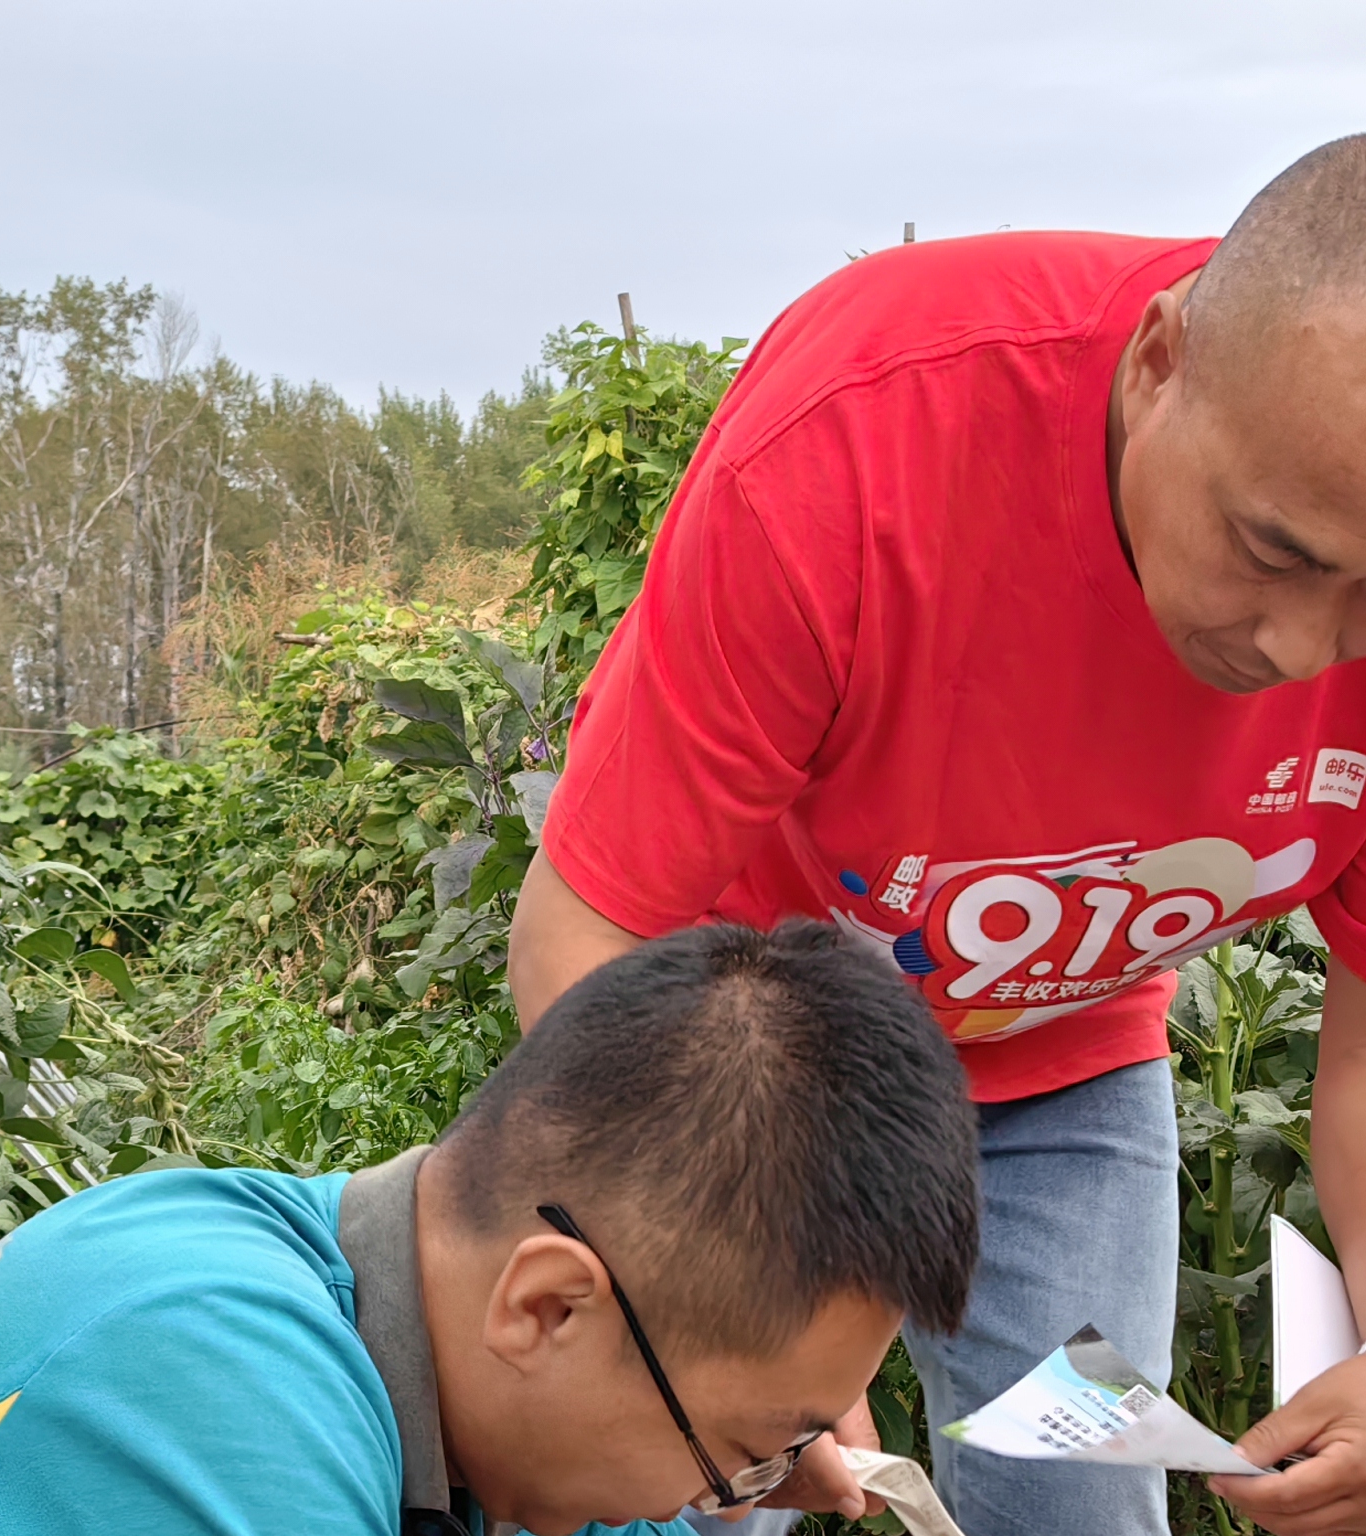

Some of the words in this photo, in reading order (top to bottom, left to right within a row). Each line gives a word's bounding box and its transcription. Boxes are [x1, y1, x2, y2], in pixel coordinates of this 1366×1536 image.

[1324, 757, 1366, 783] 邮乐
[1319, 783, 1358, 799] ule.com
[1245, 806, 1272, 815] CHINA
[879, 853, 929, 913] 邮政
[946, 873, 1216, 1000] 9.19
